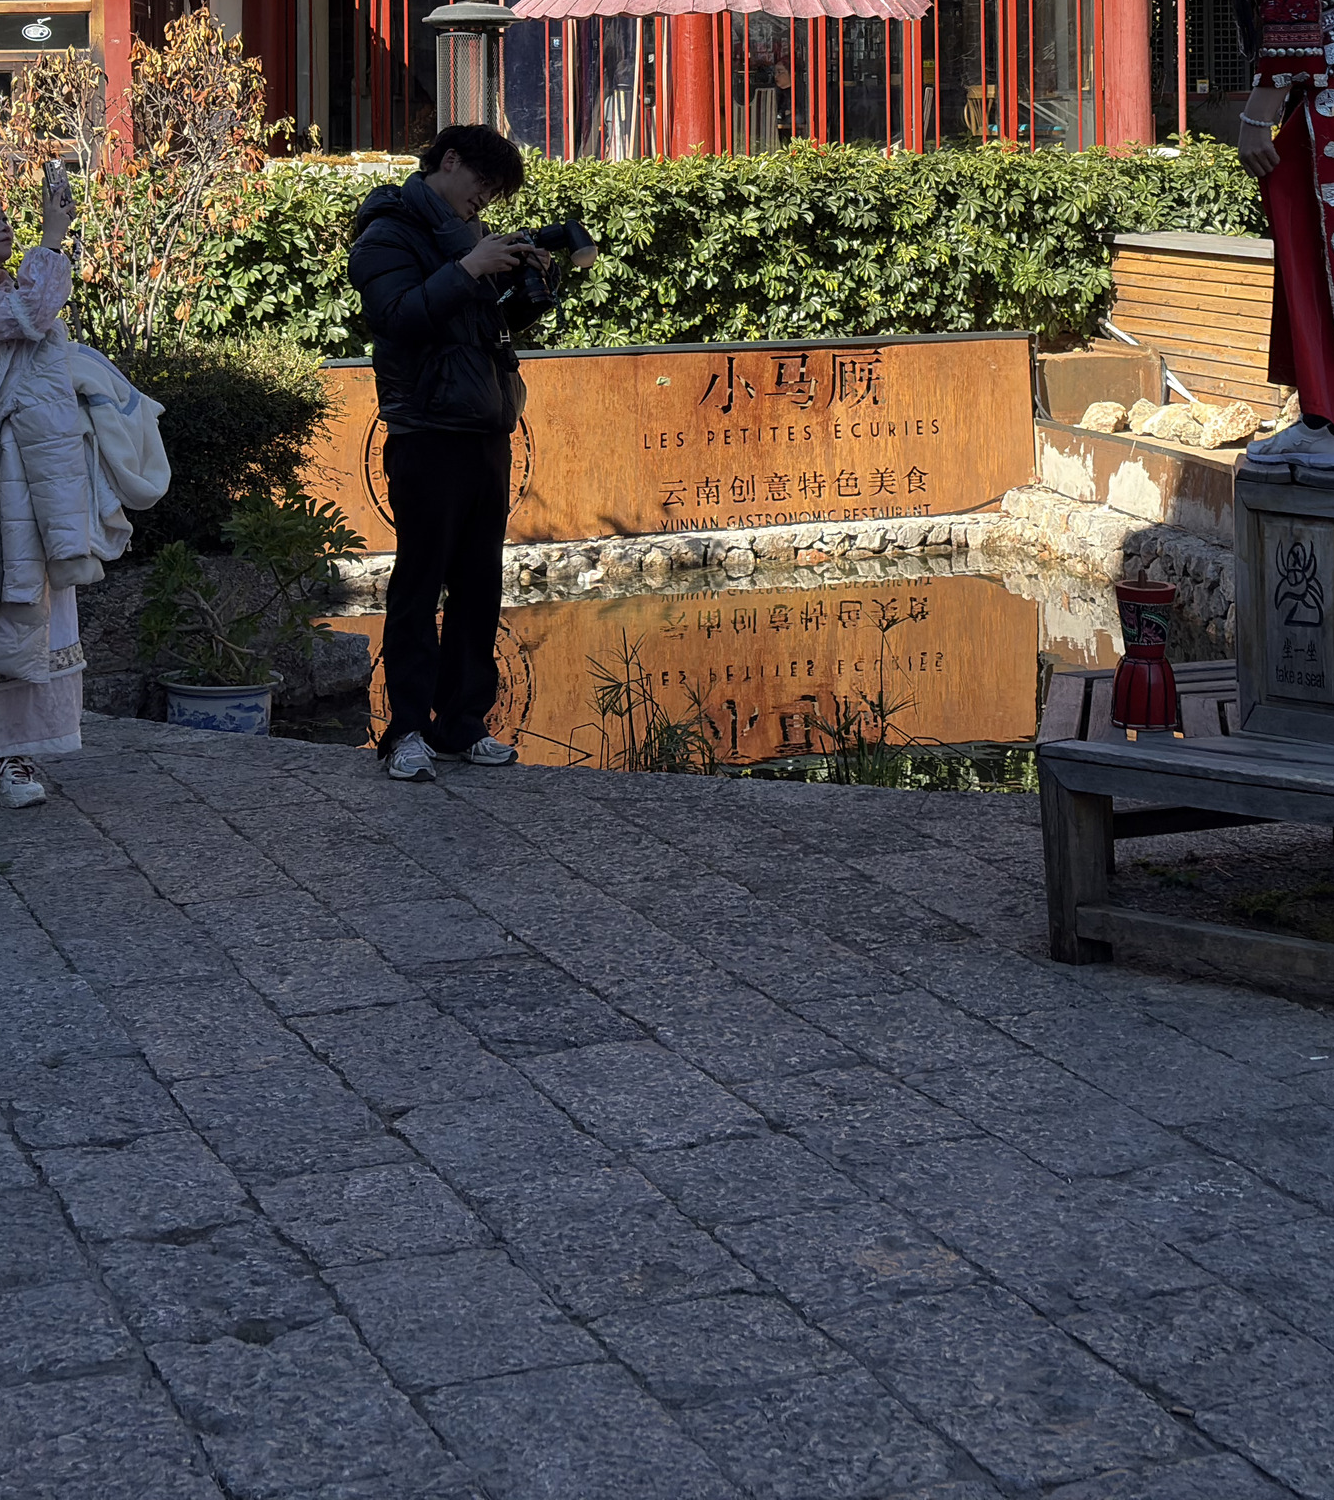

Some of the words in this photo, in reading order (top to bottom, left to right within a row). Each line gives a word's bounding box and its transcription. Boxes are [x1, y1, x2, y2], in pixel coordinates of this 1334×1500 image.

[698, 350, 887, 414] 小马厩
[643, 432, 684, 450] LES
[707, 424, 813, 447] PETITES
[834, 416, 940, 440] ÉCURIES
[658, 465, 930, 507] 云南创意特色美食
[661, 515, 719, 531] YUNNAN
[726, 510, 836, 530] GASTRONOMIC
[843, 503, 931, 520] RESTAURANT
[1282, 637, 1318, 662] 坐一坐
[1275, 665, 1295, 684] take
[1297, 671, 1303, 685] a
[1305, 671, 1325, 688] seat
